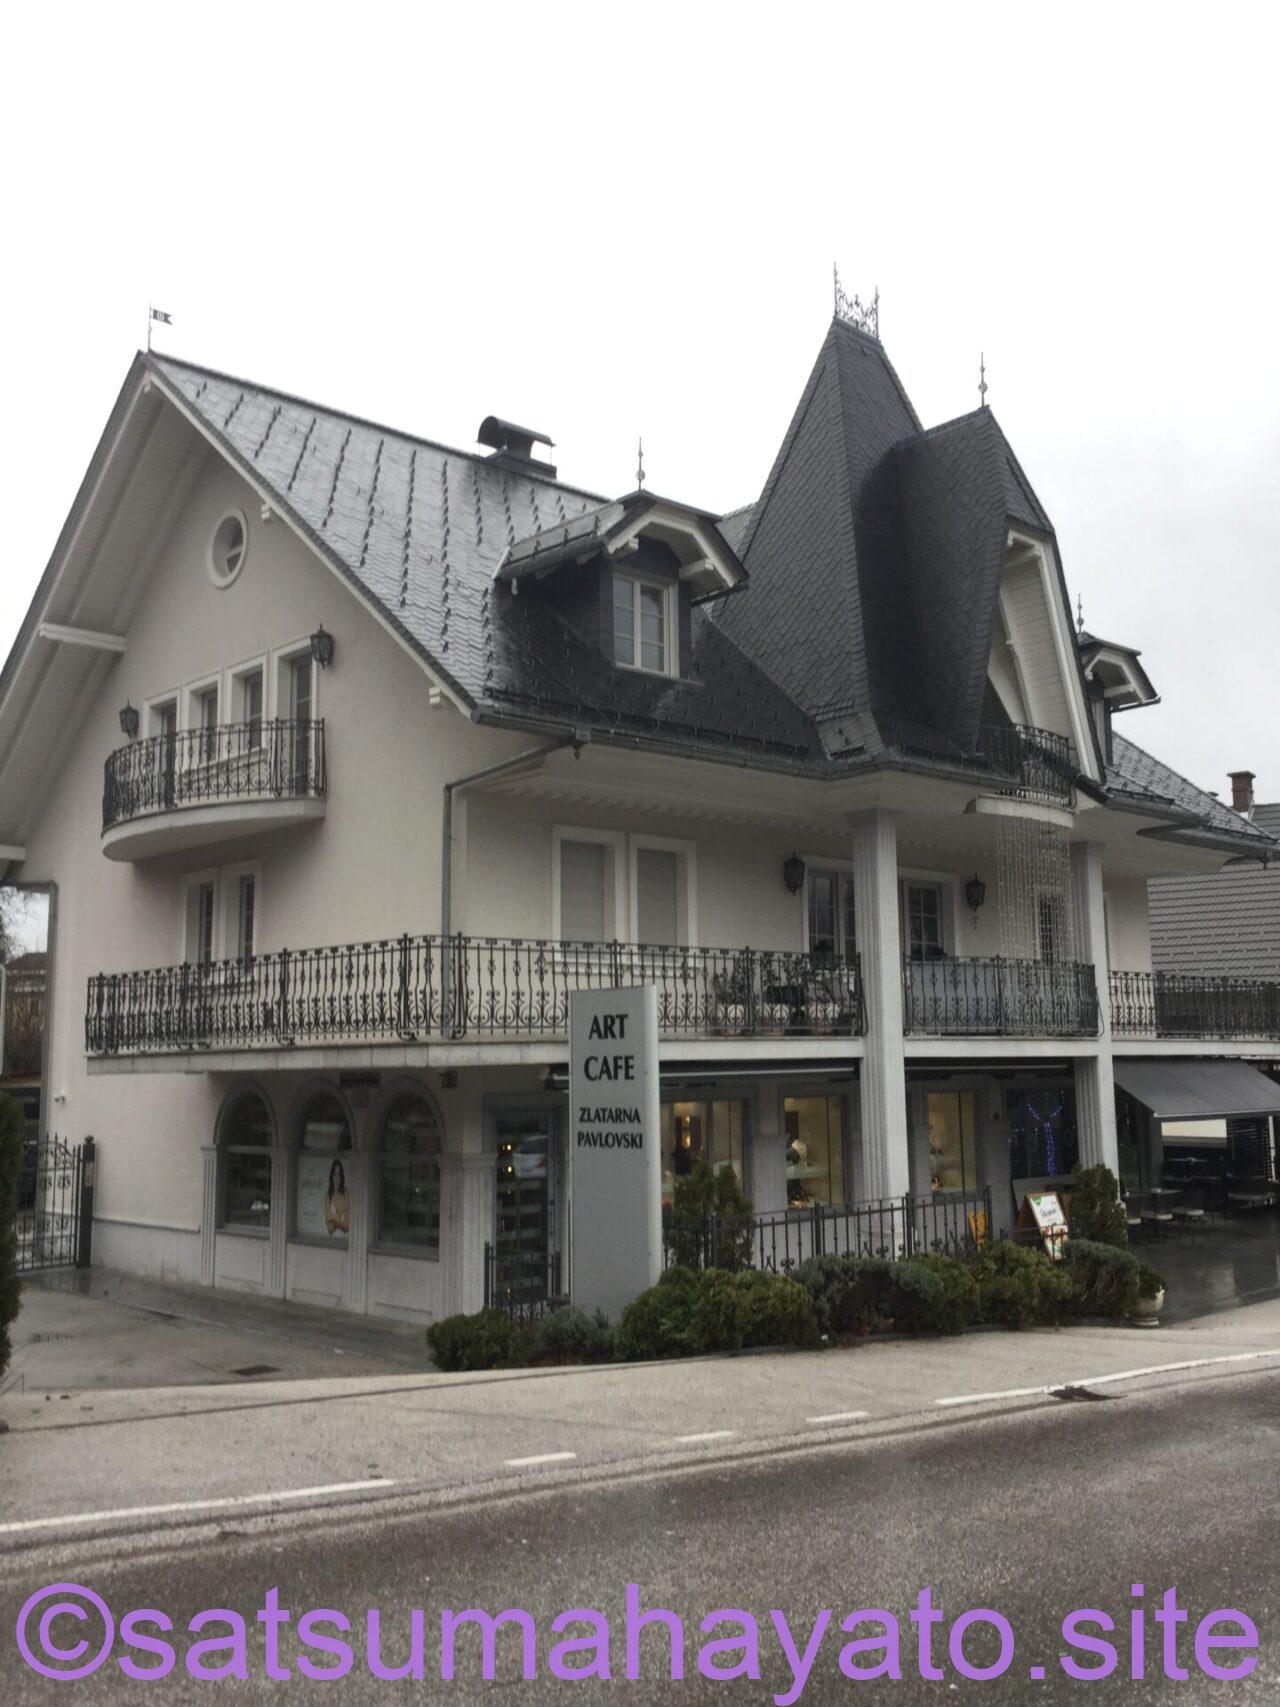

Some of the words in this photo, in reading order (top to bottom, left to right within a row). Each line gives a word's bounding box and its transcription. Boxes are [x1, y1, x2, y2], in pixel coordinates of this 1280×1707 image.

[588, 1014, 628, 1039] ART
[584, 1056, 635, 1081] CAFE
[579, 1107, 641, 1124] ZLATARNA
[577, 1131, 643, 1149] PAVLOVSKI
